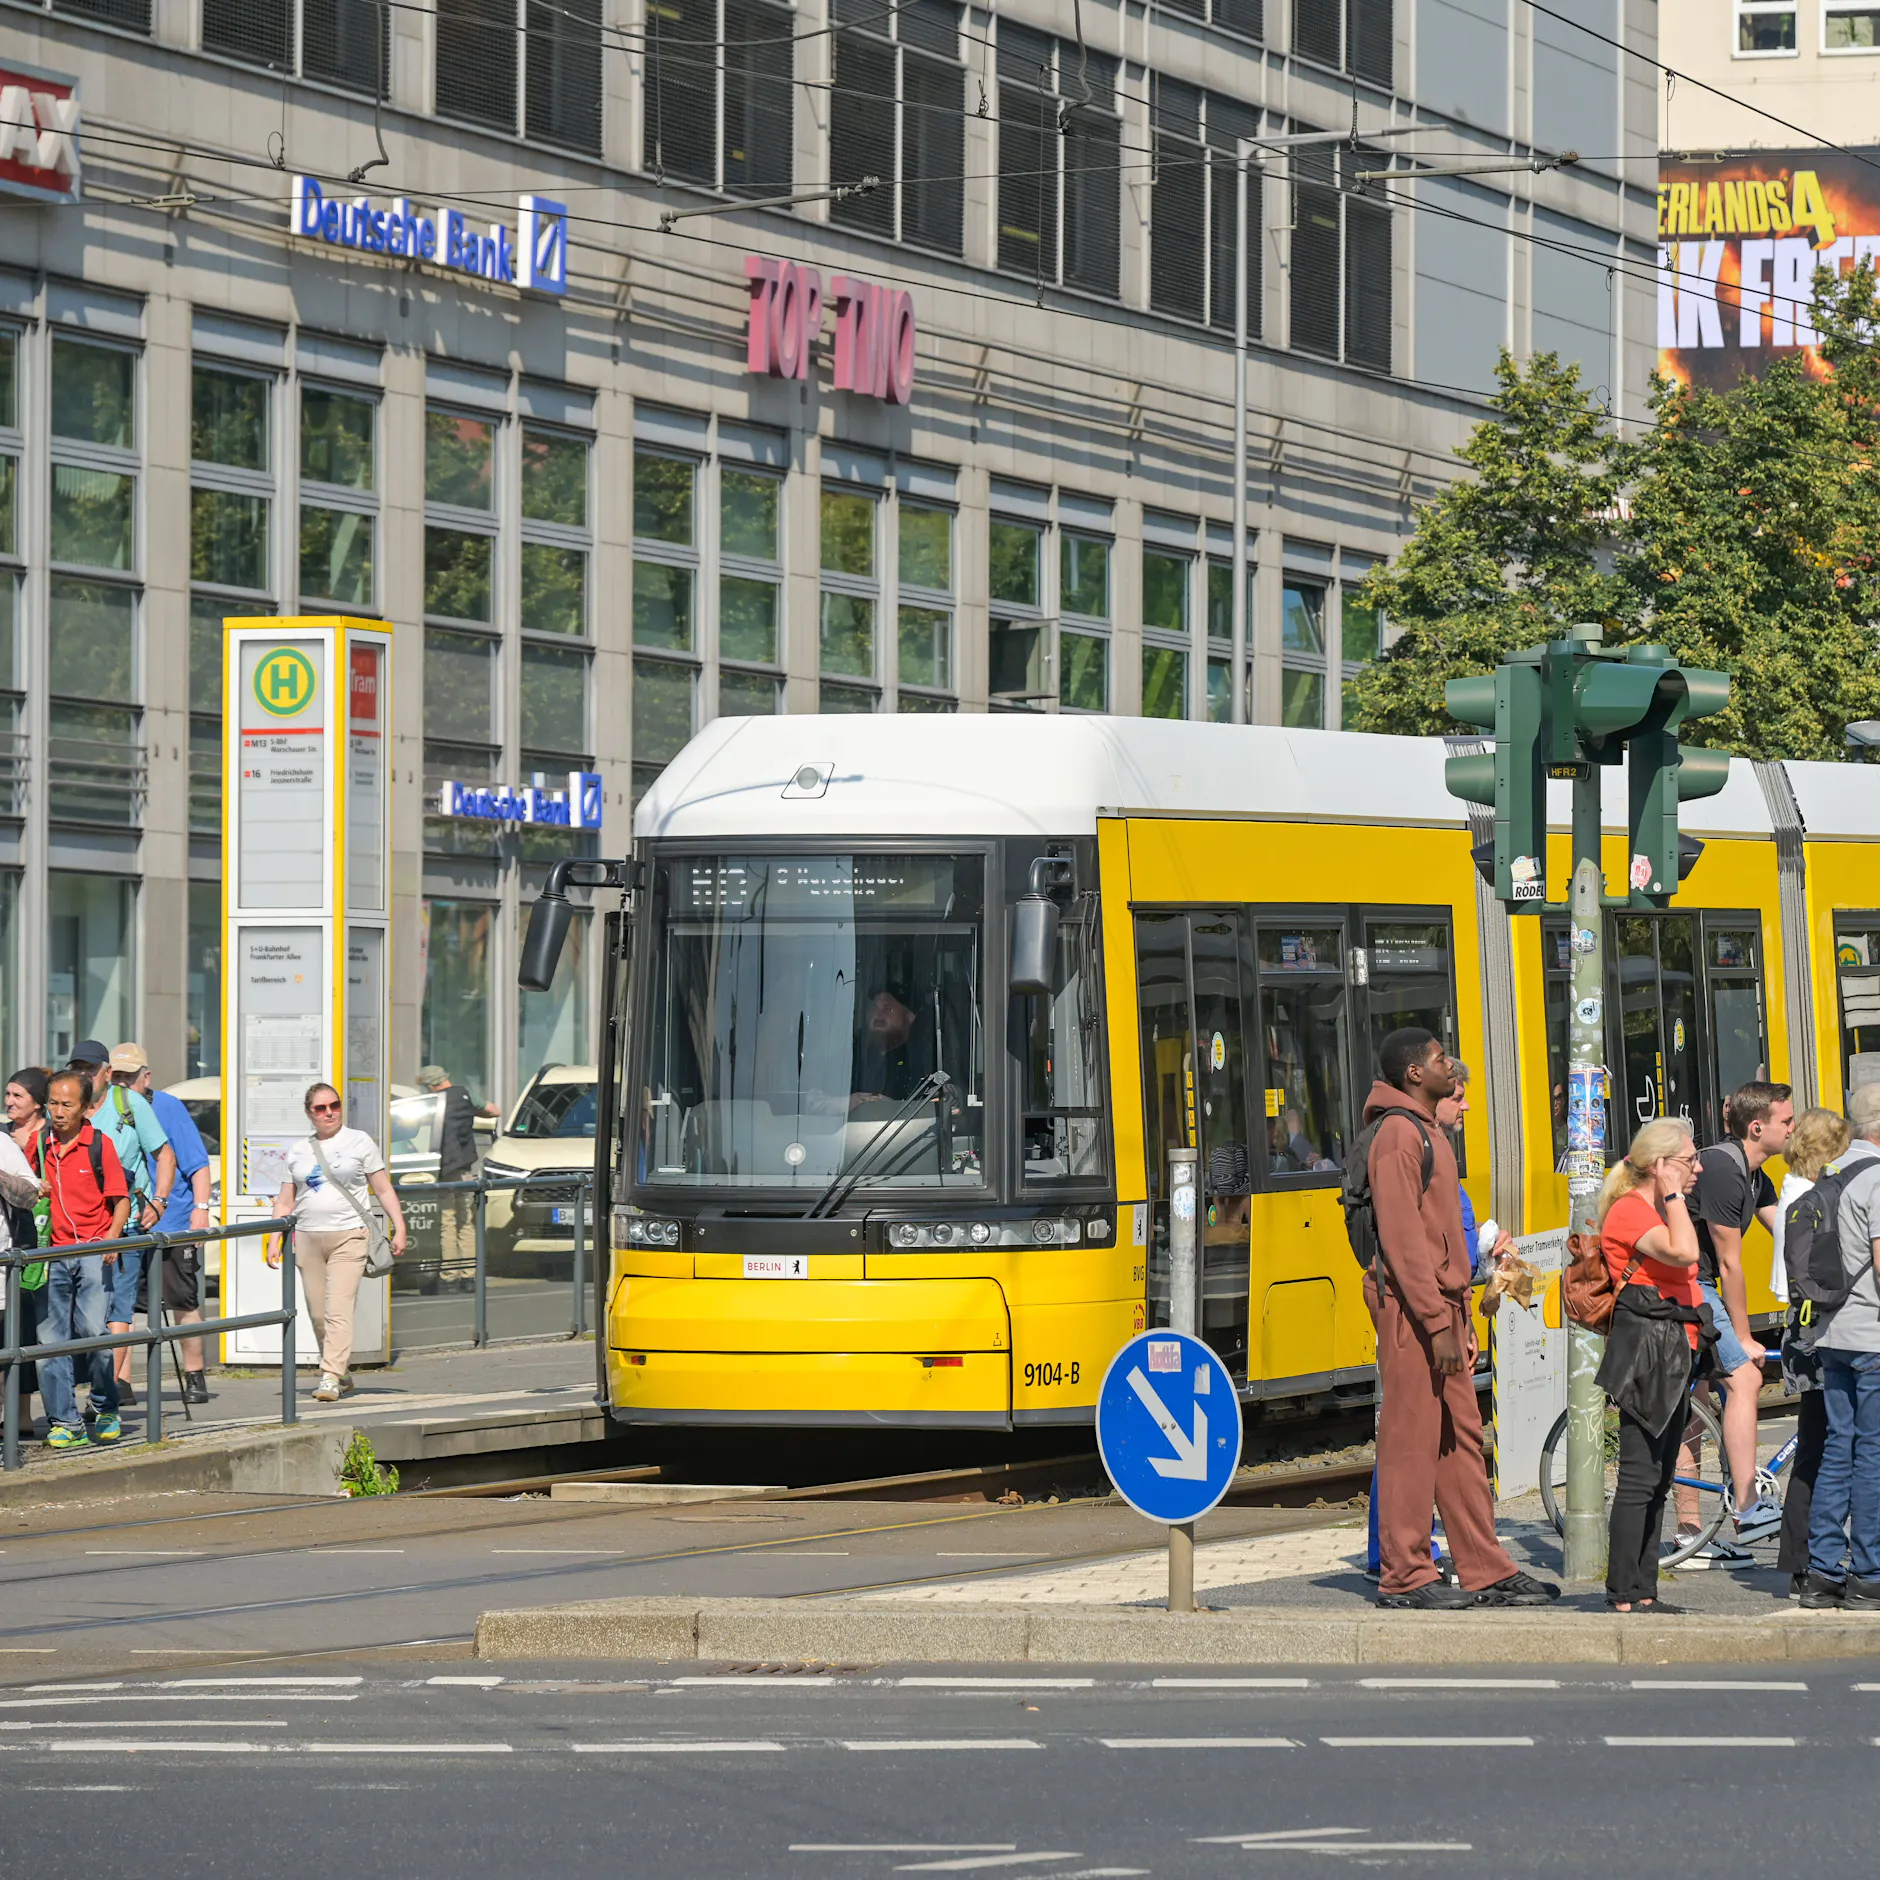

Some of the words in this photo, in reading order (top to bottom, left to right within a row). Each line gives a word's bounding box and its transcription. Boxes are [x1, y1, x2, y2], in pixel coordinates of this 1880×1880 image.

[1792, 170, 1837, 251] 4
[291, 175, 436, 259] Deutsche
[438, 207, 513, 282] Bank
[745, 255, 822, 379] TOP
[830, 275, 916, 405] TWO
[270, 663, 298, 700] H
[250, 739, 267, 748] M13
[270, 745, 306, 753] Warschauer
[251, 769, 261, 778] 16
[1551, 767, 1577, 777] HFR2
[270, 776, 312, 784] Jessnerstraße
[443, 780, 527, 821] Deutsche
[250, 953, 285, 961] Frankfurter
[250, 976, 287, 984] Tarifbereich
[409, 1216, 435, 1230] für
[747, 1262, 782, 1271] BERLIN
[1133, 1265, 1145, 1282] BVG
[1133, 1318, 1144, 1330] VBB
[1023, 1361, 1080, 1387] 9104-B
